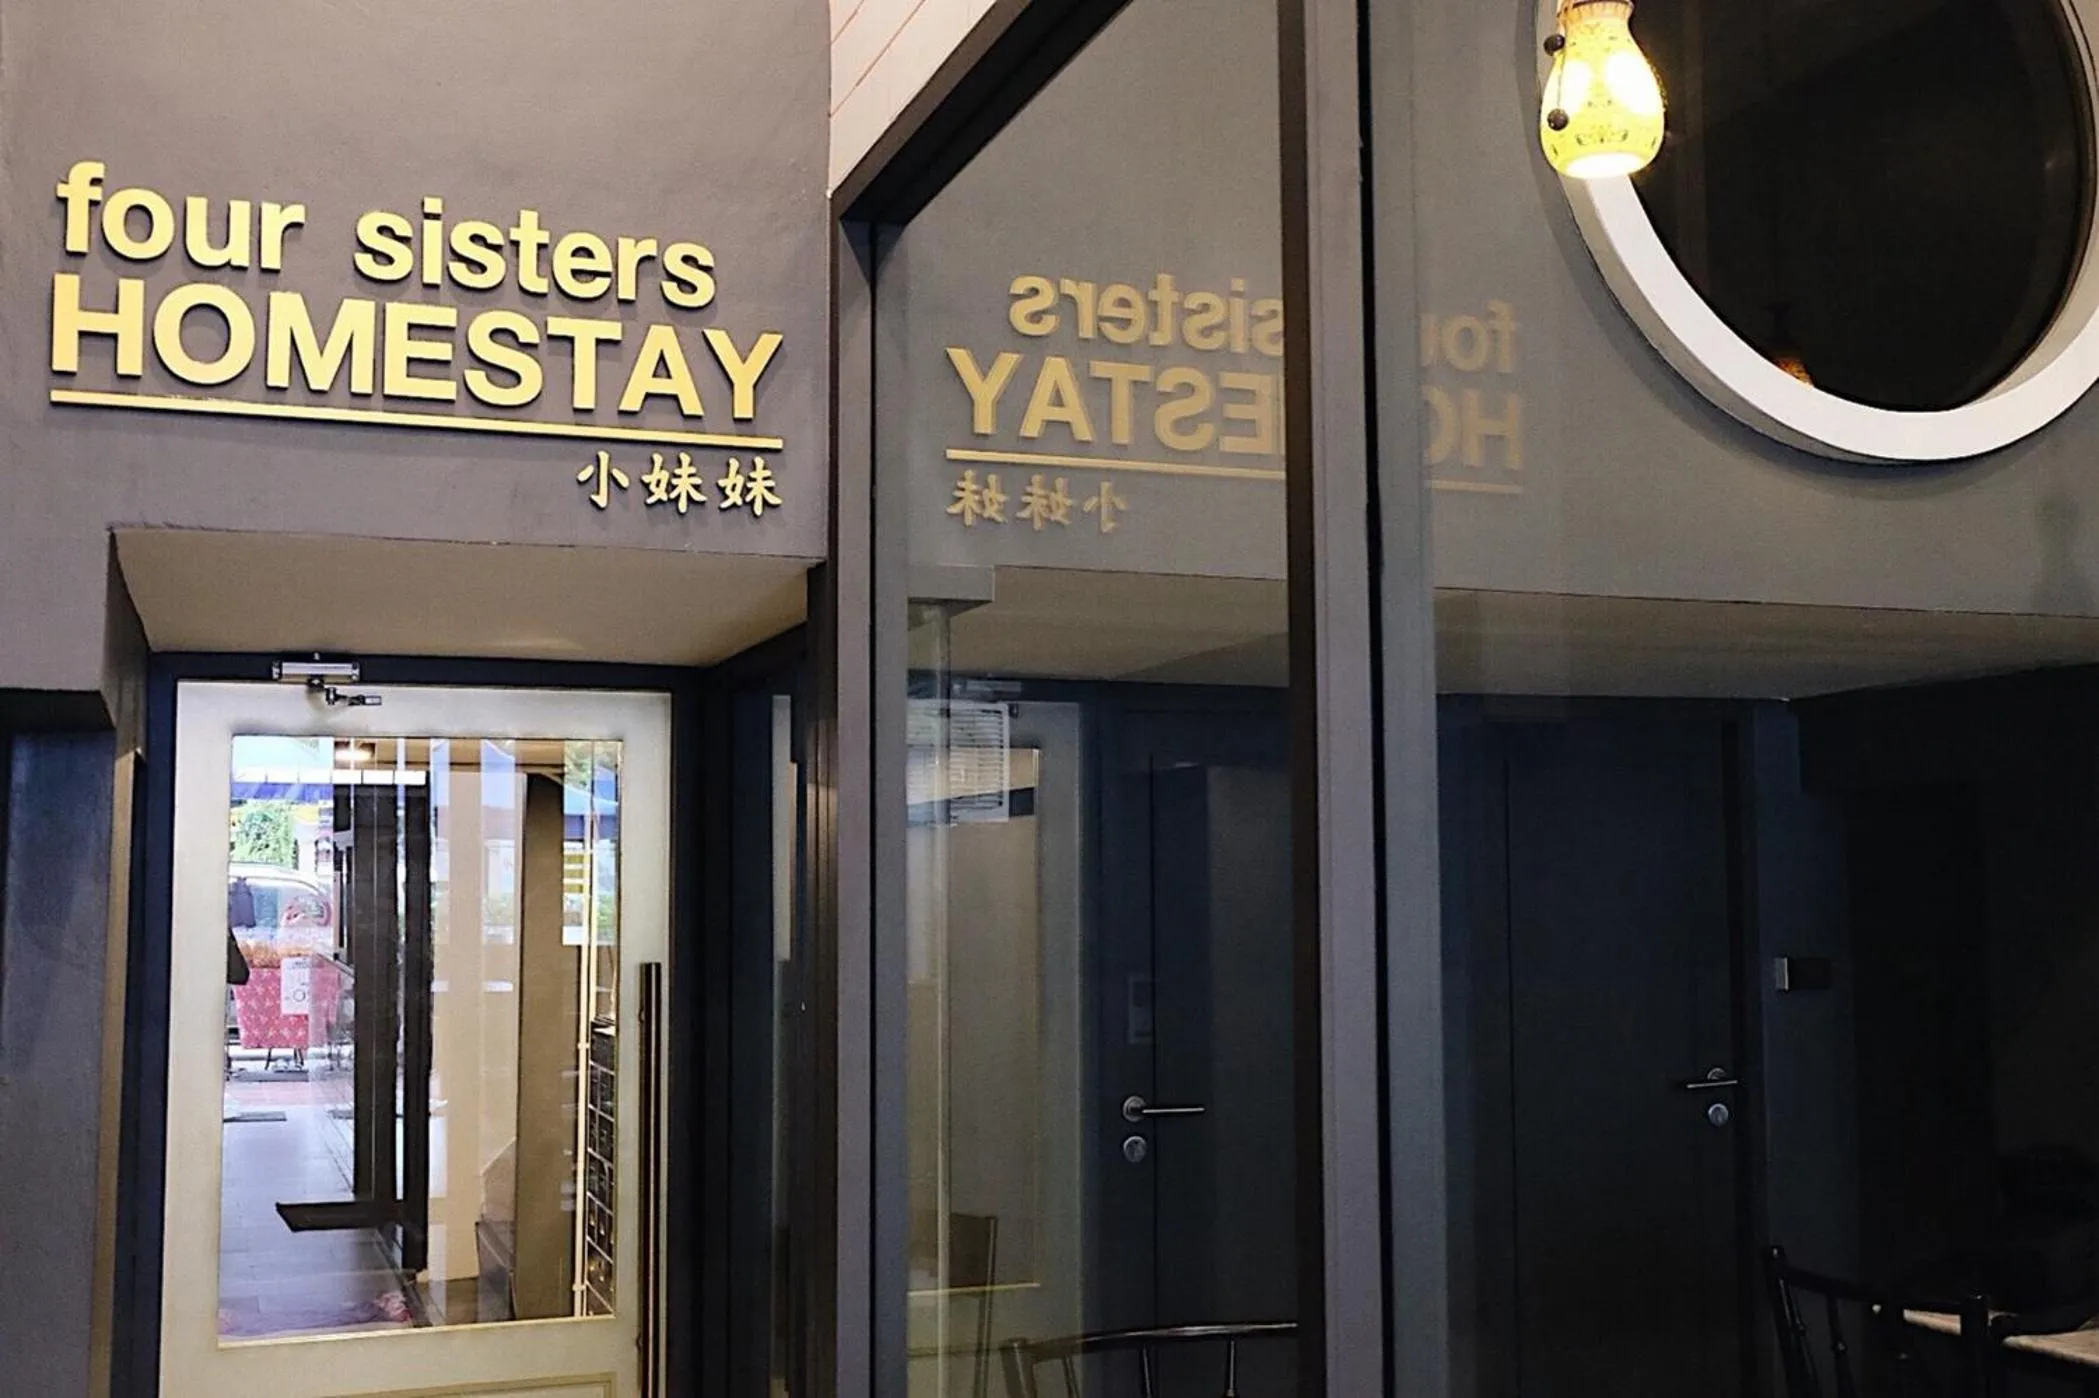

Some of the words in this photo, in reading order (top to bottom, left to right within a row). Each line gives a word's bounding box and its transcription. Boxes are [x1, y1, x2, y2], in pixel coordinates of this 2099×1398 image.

[56, 160, 307, 270] four
[353, 197, 715, 306] sisters
[51, 272, 783, 419] HOMESTAY
[576, 450, 783, 517] 小妹妹
